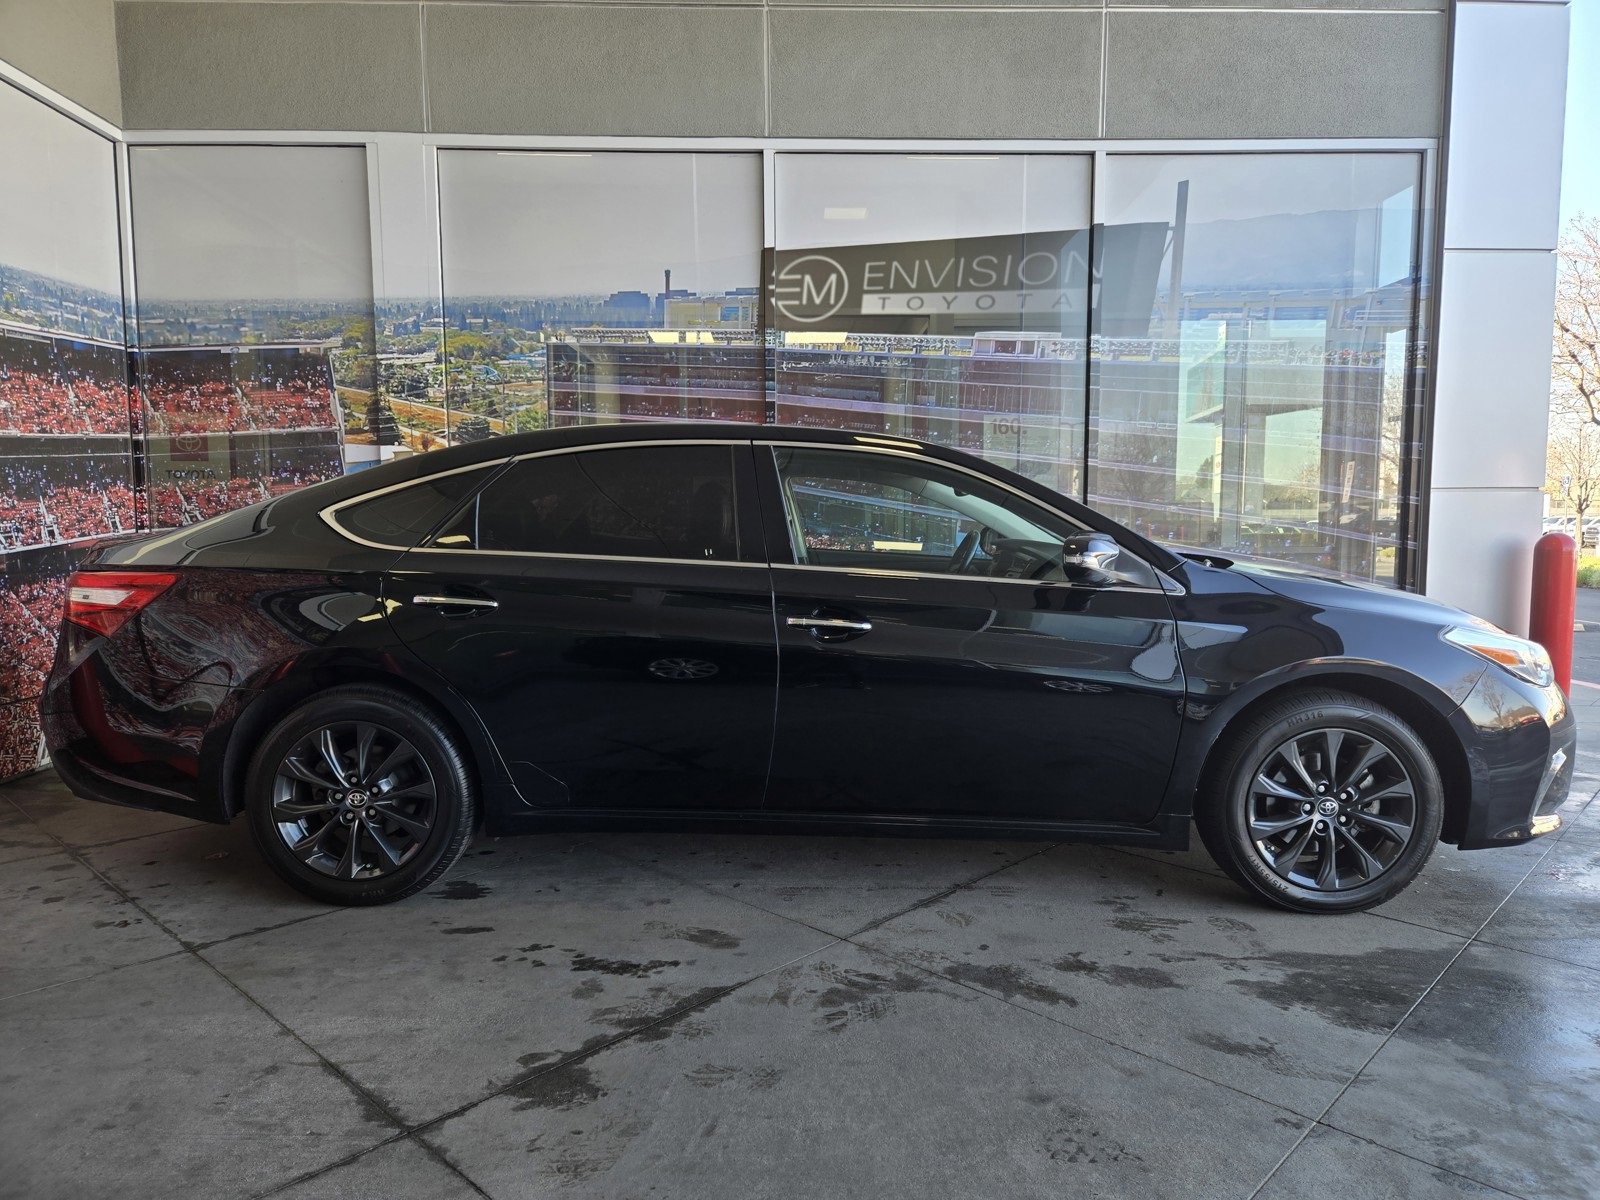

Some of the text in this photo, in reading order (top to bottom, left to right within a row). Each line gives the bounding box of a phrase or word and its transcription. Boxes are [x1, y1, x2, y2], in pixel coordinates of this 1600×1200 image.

[863, 248, 1105, 291] ENVISION
[877, 293, 1073, 311] TOYOTA
[166, 470, 215, 479] TOYOTA
